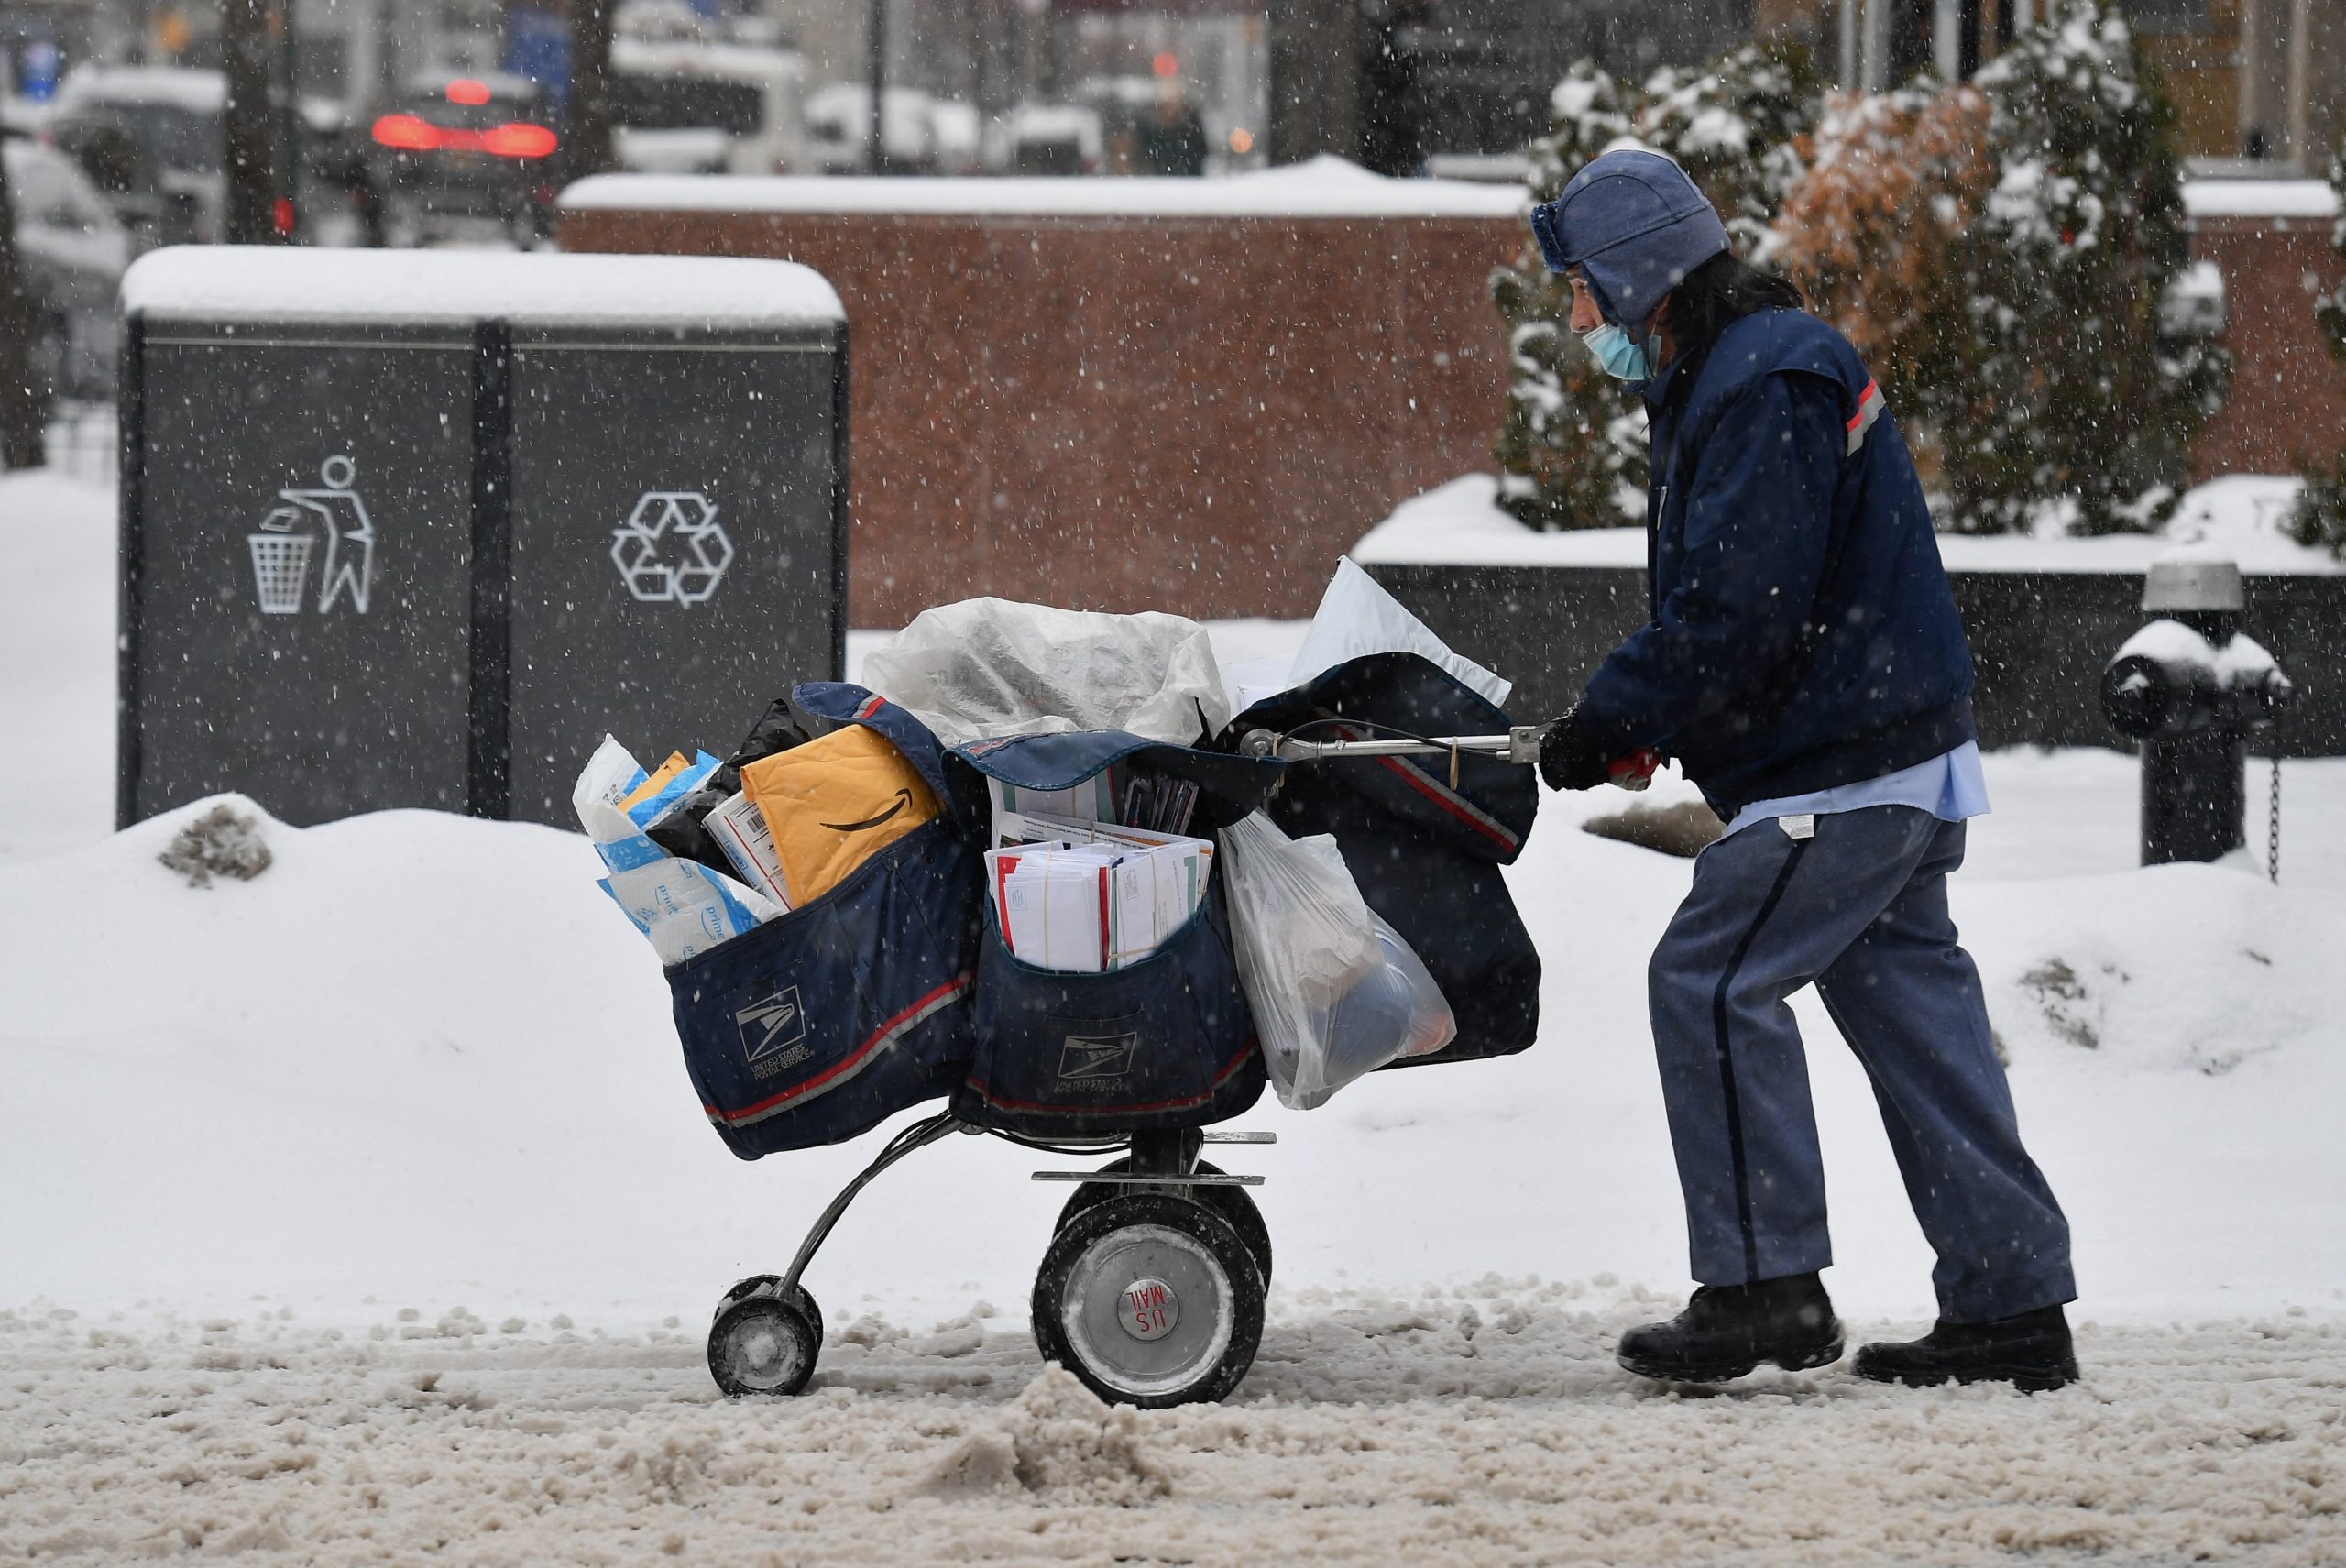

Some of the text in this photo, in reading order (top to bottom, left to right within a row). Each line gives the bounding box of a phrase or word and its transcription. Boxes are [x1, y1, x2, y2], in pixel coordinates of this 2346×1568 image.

[706, 906, 725, 939] prime
[751, 1043, 805, 1072] UNITED STATES
[754, 1066, 783, 1080] POSTAL
[1126, 1285, 1165, 1311] MAIL
